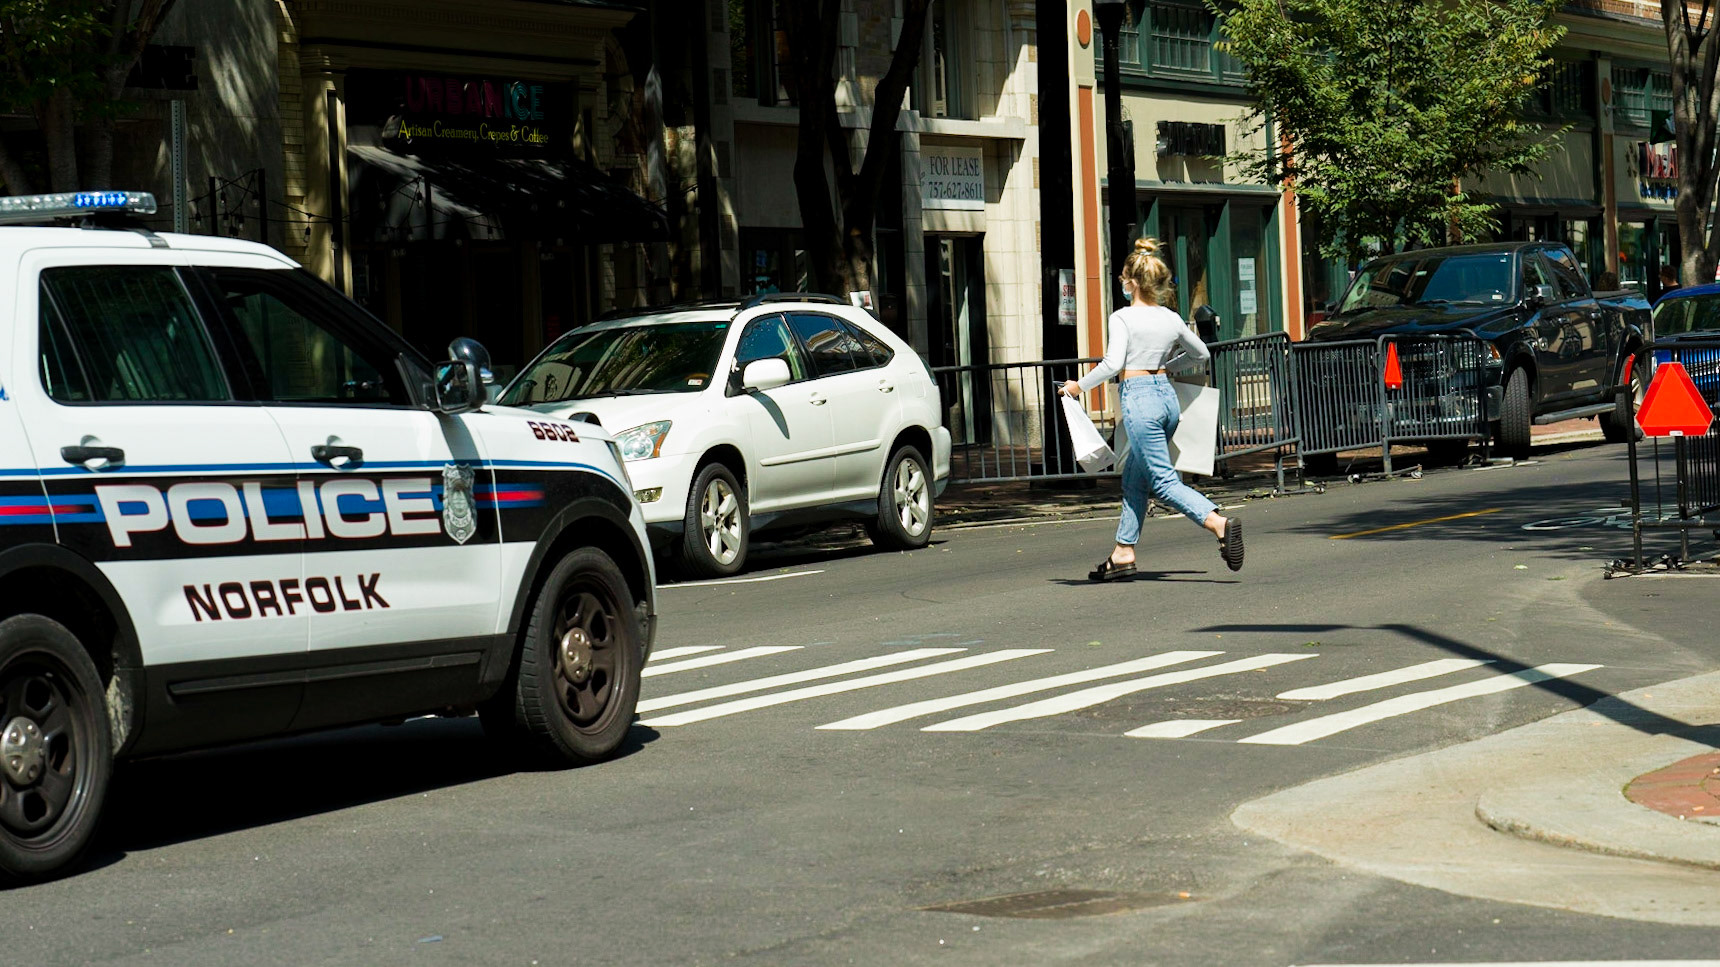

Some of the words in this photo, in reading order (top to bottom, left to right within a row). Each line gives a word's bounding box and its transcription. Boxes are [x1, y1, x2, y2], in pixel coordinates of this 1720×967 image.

[398, 120, 433, 139] Artisan
[480, 123, 509, 143] Crepes
[510, 125, 520, 142] &
[521, 125, 549, 143] Coffee
[929, 156, 949, 176] FOR
[952, 157, 980, 177] LEASE
[94, 478, 442, 548] POLICE
[183, 572, 391, 622] NORFOLK
